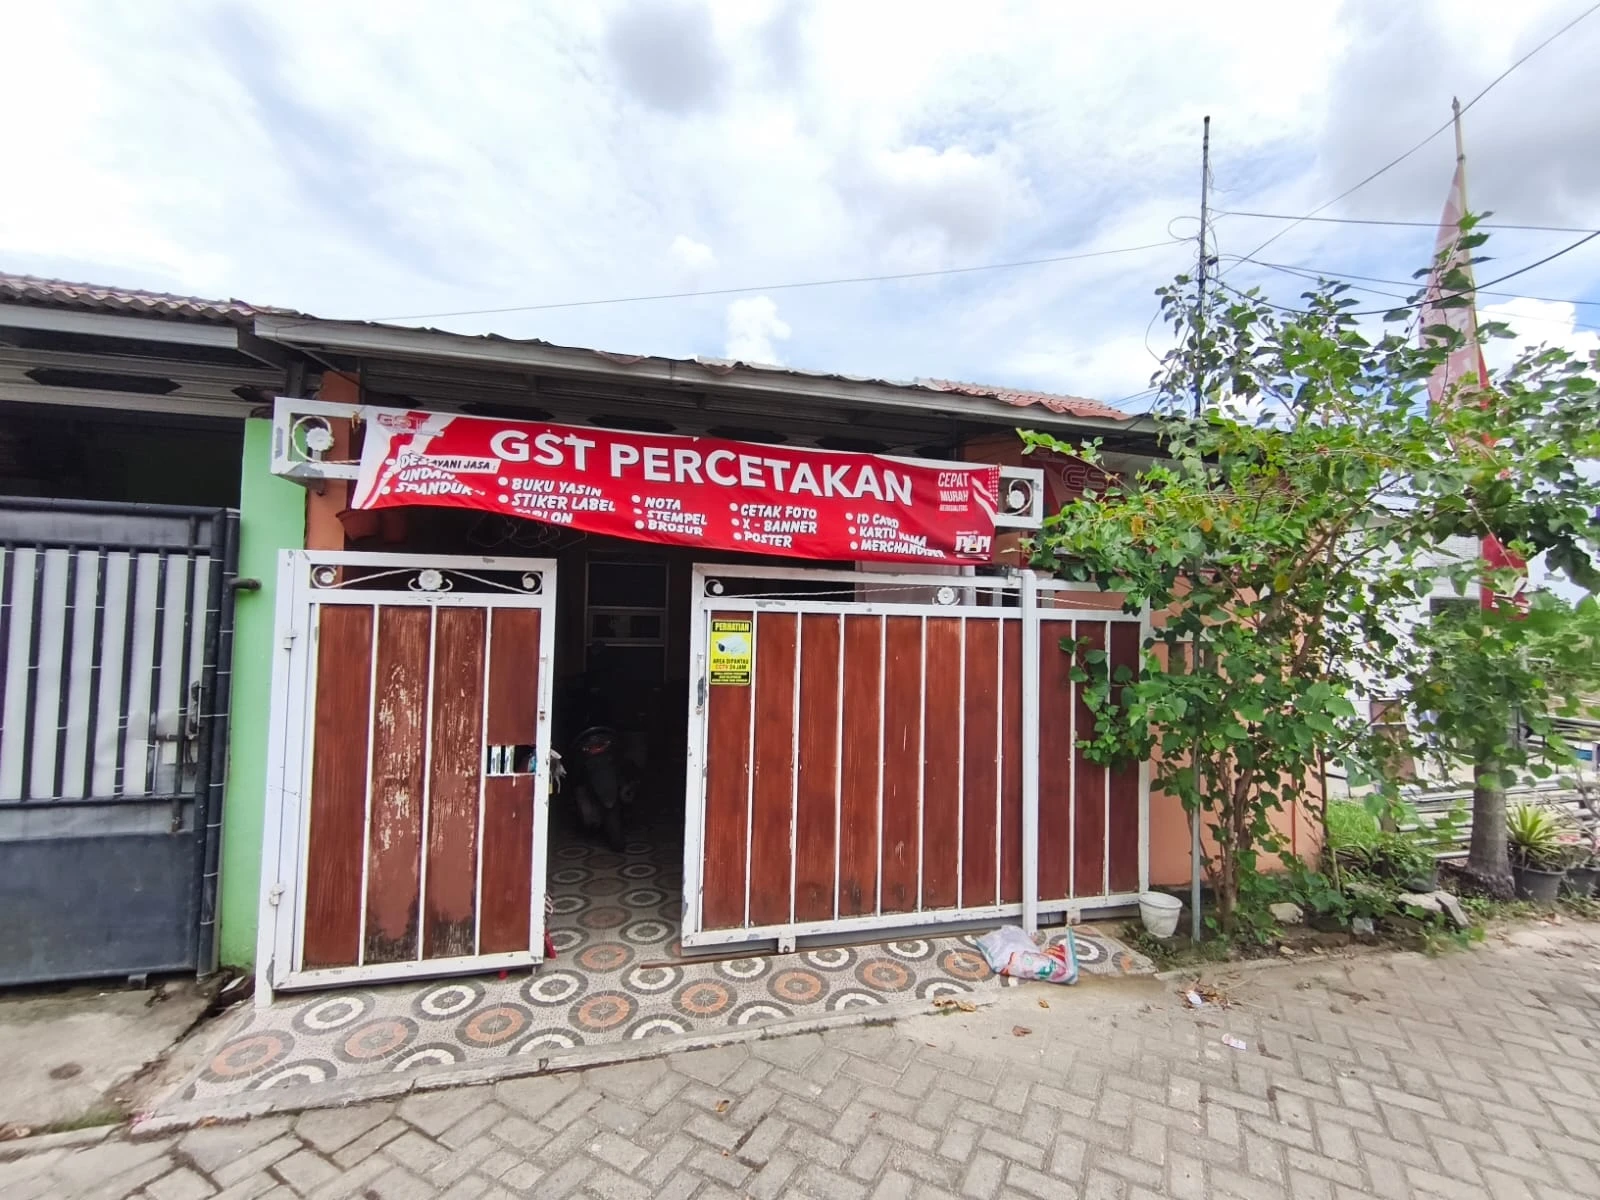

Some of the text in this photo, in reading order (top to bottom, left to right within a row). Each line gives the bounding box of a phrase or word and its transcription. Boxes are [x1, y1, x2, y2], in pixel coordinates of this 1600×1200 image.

[464, 460, 490, 470] JASA
[490, 429, 913, 506] GST PERCETAKAN
[511, 478, 602, 497] BUKU YASIN
[937, 472, 969, 488] CEPAT
[511, 493, 616, 513] STIKER LABEL
[644, 497, 681, 510] NOTA
[939, 490, 969, 503] MURAH
[647, 510, 708, 526] STEMPEL
[740, 503, 817, 520] CETAK FOTO
[743, 518, 750, 530] X
[763, 519, 817, 534] BANNER
[856, 513, 899, 529] ID CARD
[648, 522, 703, 537] BROSUR
[859, 527, 896, 540] KARTU
[744, 532, 792, 548] POSTER
